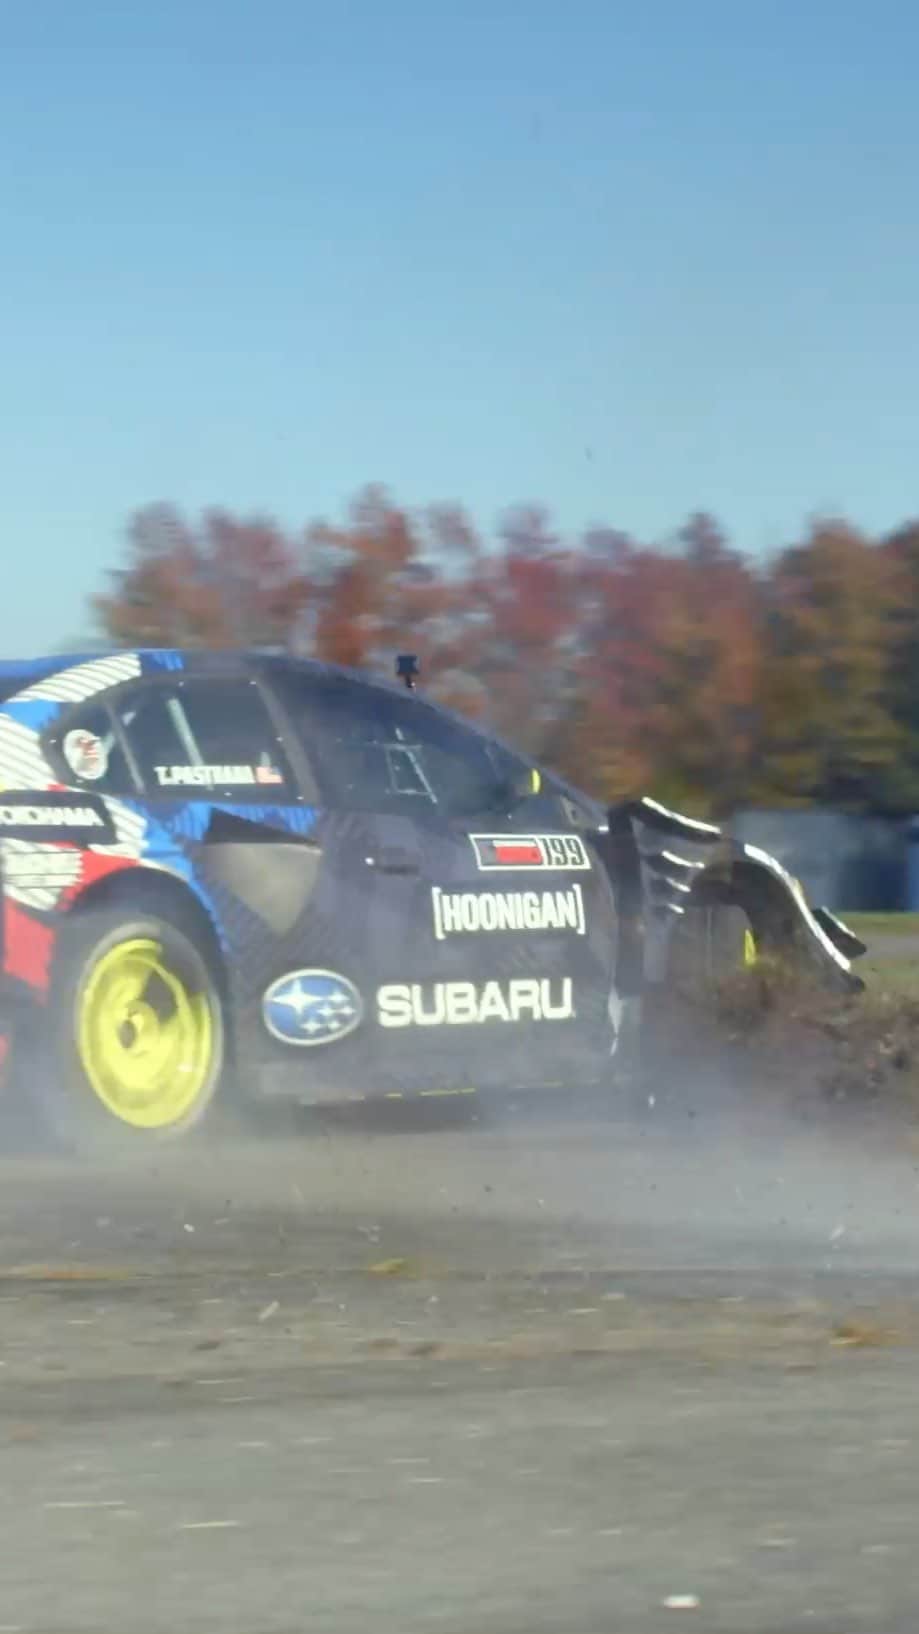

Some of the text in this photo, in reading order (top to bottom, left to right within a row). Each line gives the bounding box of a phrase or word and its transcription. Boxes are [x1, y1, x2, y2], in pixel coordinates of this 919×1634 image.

[0, 805, 105, 827] OKOHAMA
[539, 837, 586, 867] 199
[376, 977, 573, 1028] SUBARU
